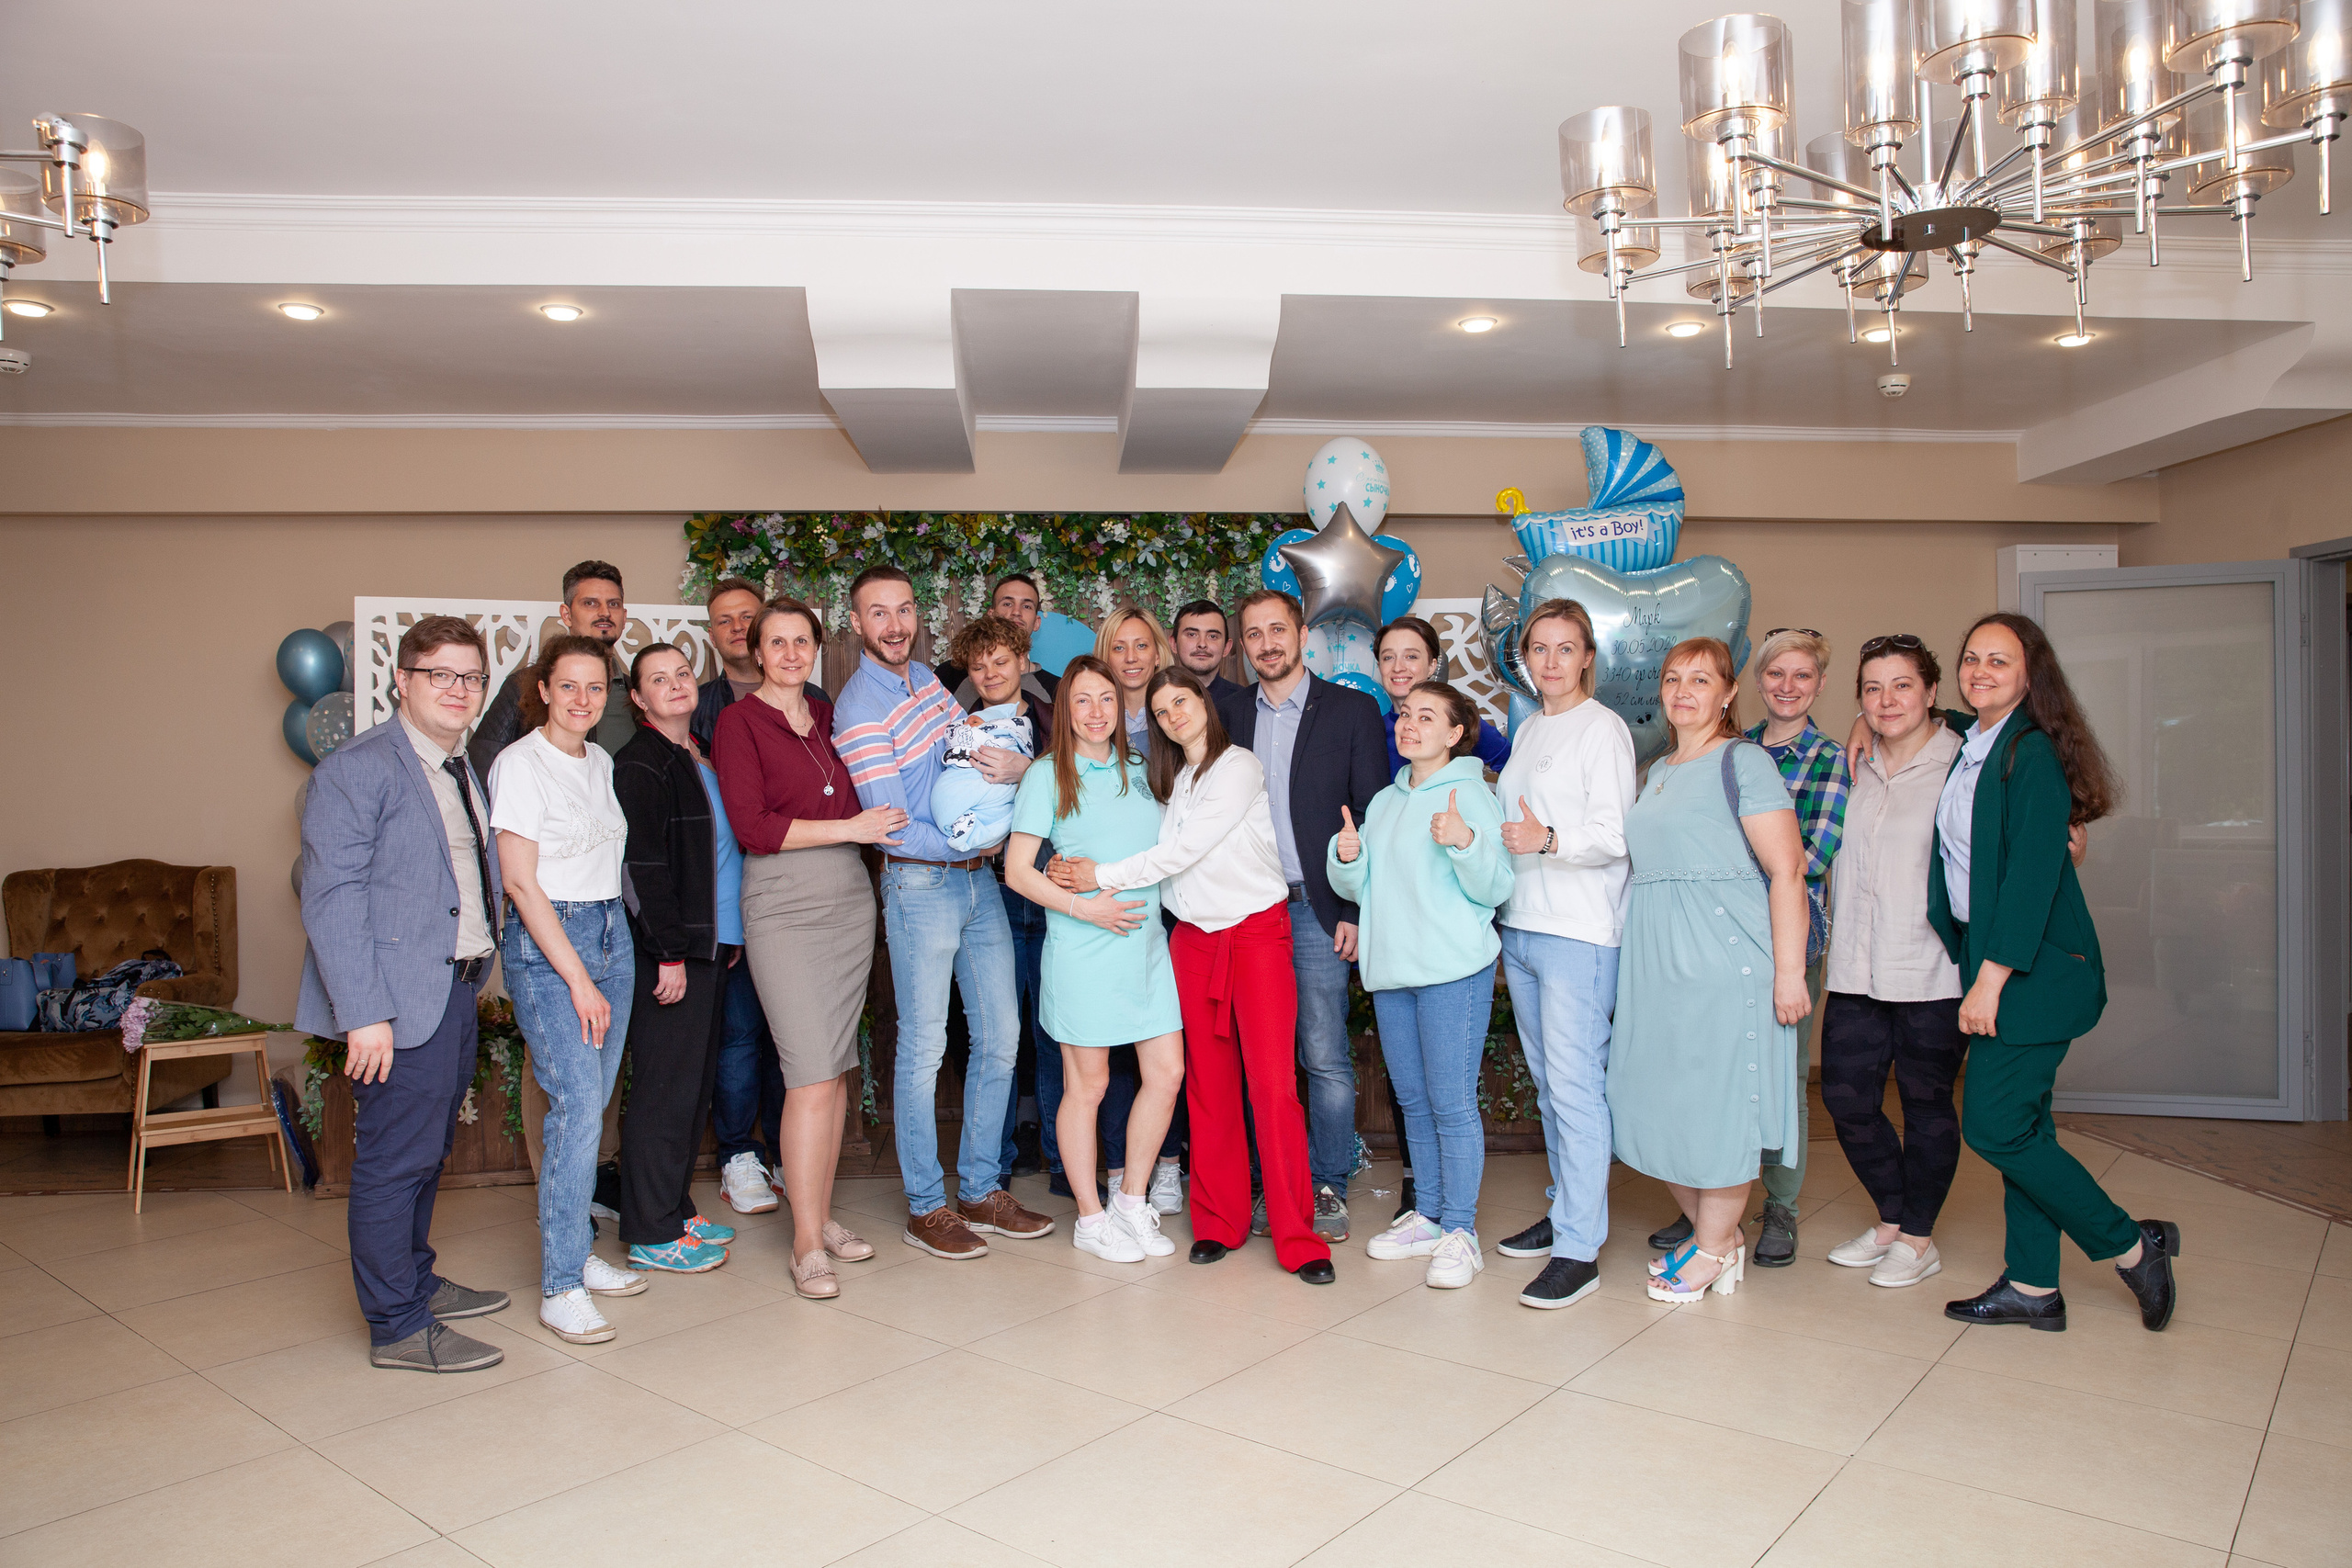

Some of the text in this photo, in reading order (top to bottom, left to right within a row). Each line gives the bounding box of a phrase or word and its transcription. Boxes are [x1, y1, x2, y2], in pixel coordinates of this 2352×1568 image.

[1570, 519, 1644, 540] it's a Boy!
[1623, 603, 1661, 635] Марк
[1332, 663, 1361, 672] НОЧКА
[1602, 666, 1632, 682] 3340
[1635, 669, 1646, 691] гр
[1613, 692, 1630, 706] 52
[1630, 695, 1645, 706] см
